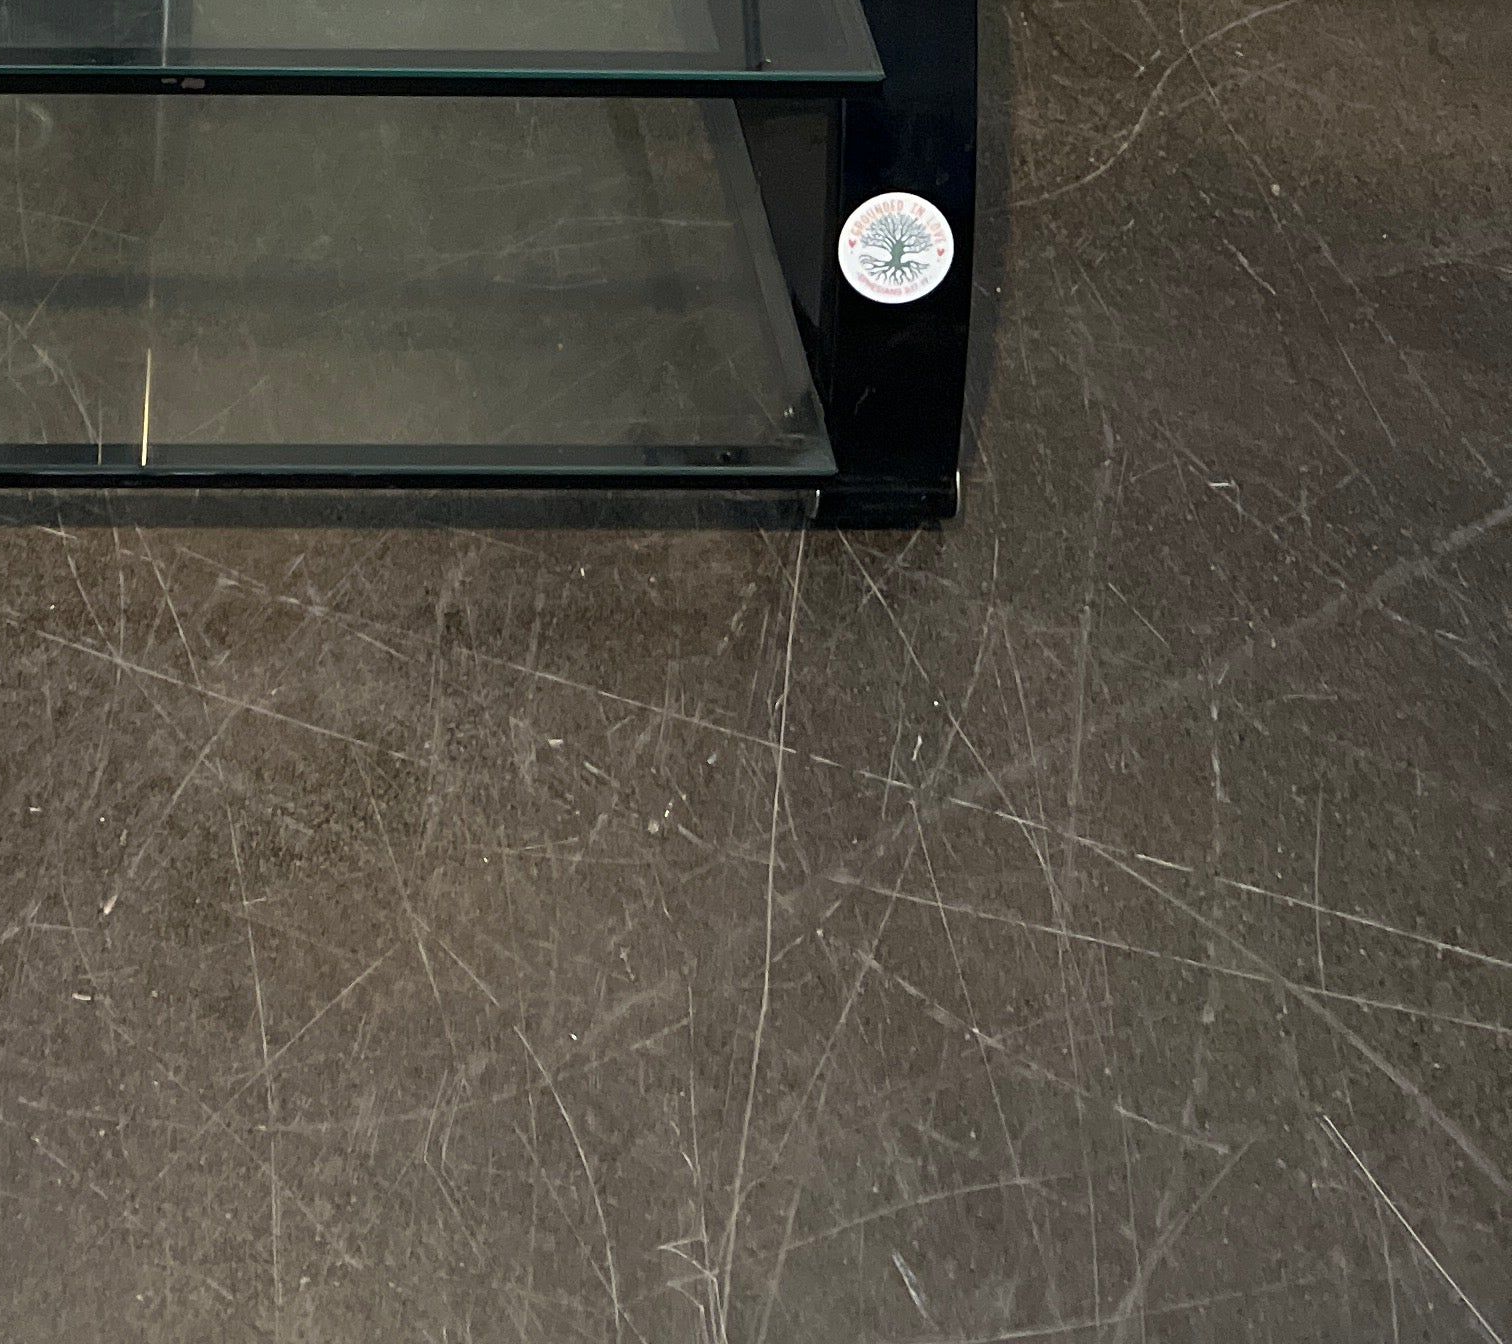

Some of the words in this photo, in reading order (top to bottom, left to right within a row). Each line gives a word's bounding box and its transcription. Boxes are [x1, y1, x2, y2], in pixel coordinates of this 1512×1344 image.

[851, 199, 904, 237] GROUNDED
[912, 202, 926, 217] IN
[927, 214, 946, 244] LOVE
